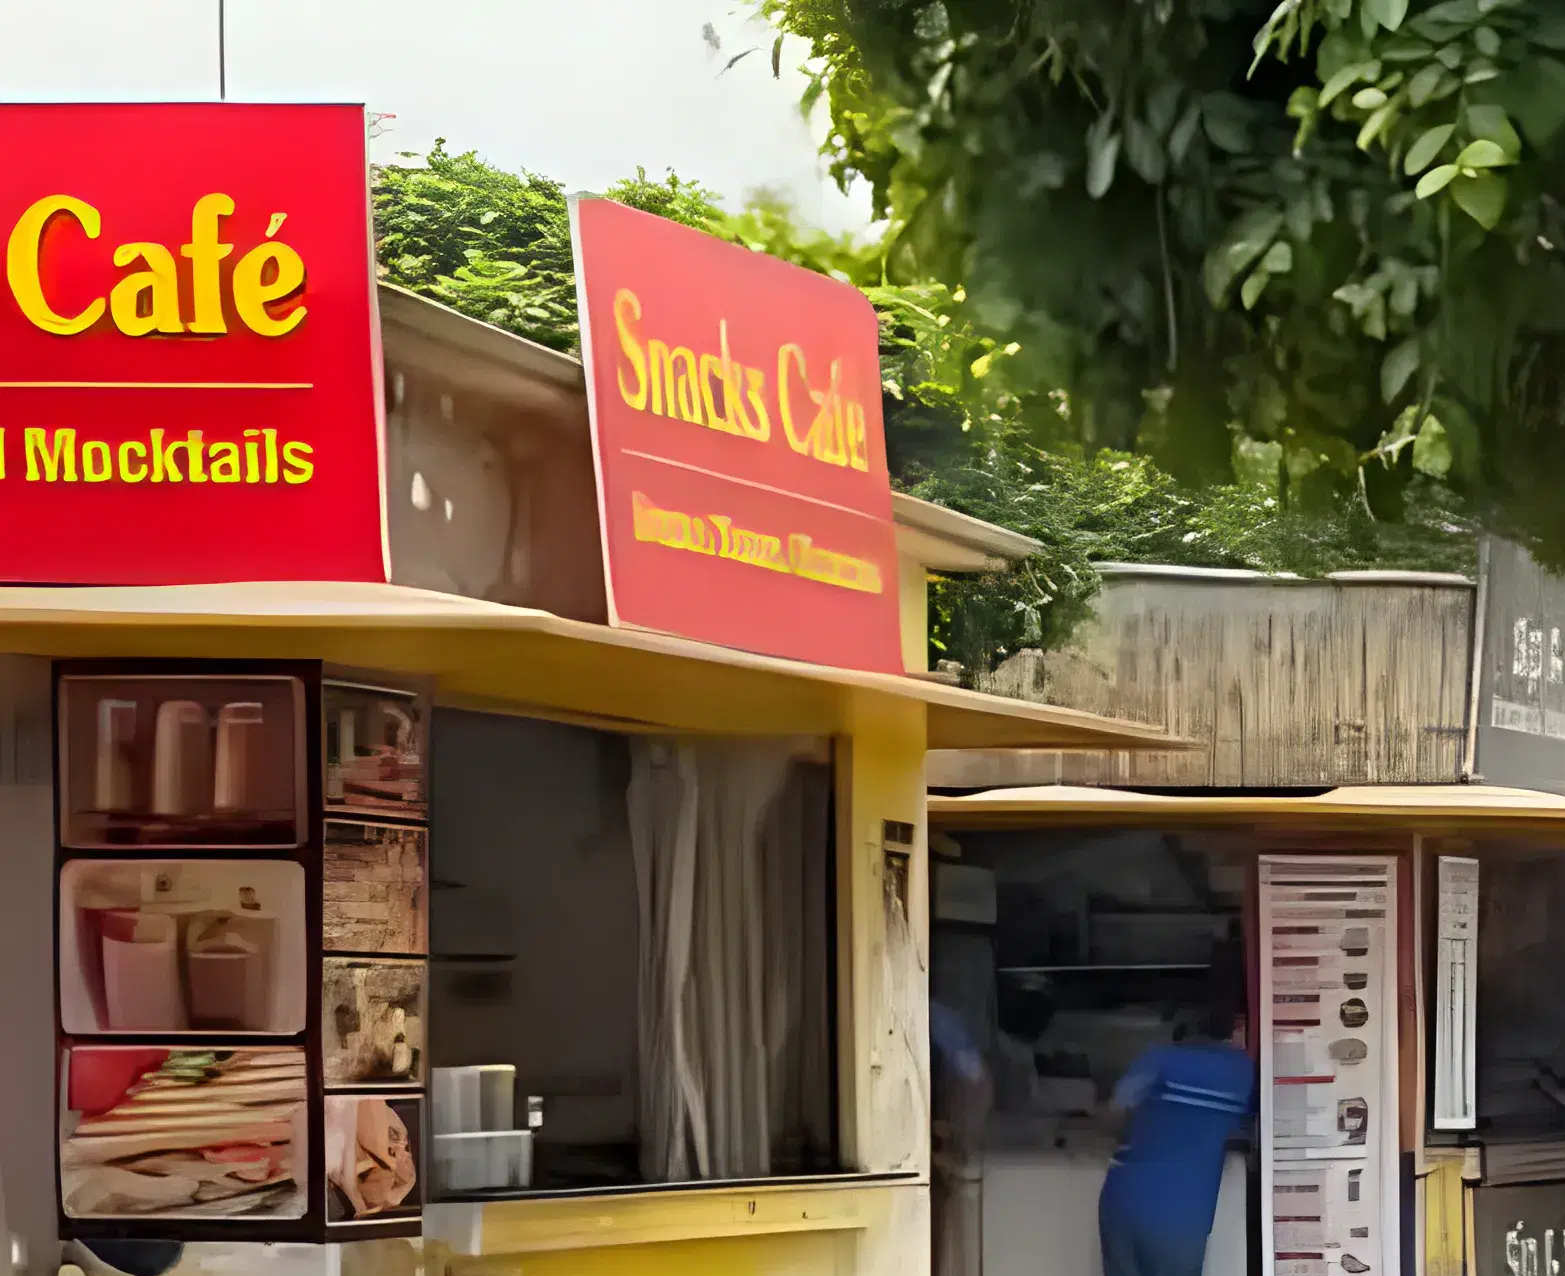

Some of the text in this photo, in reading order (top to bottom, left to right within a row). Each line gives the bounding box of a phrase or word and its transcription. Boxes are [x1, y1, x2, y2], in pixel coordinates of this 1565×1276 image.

[7, 193, 308, 337] Café
[613, 287, 771, 442] Snacks
[24, 427, 315, 484] Mocktails
